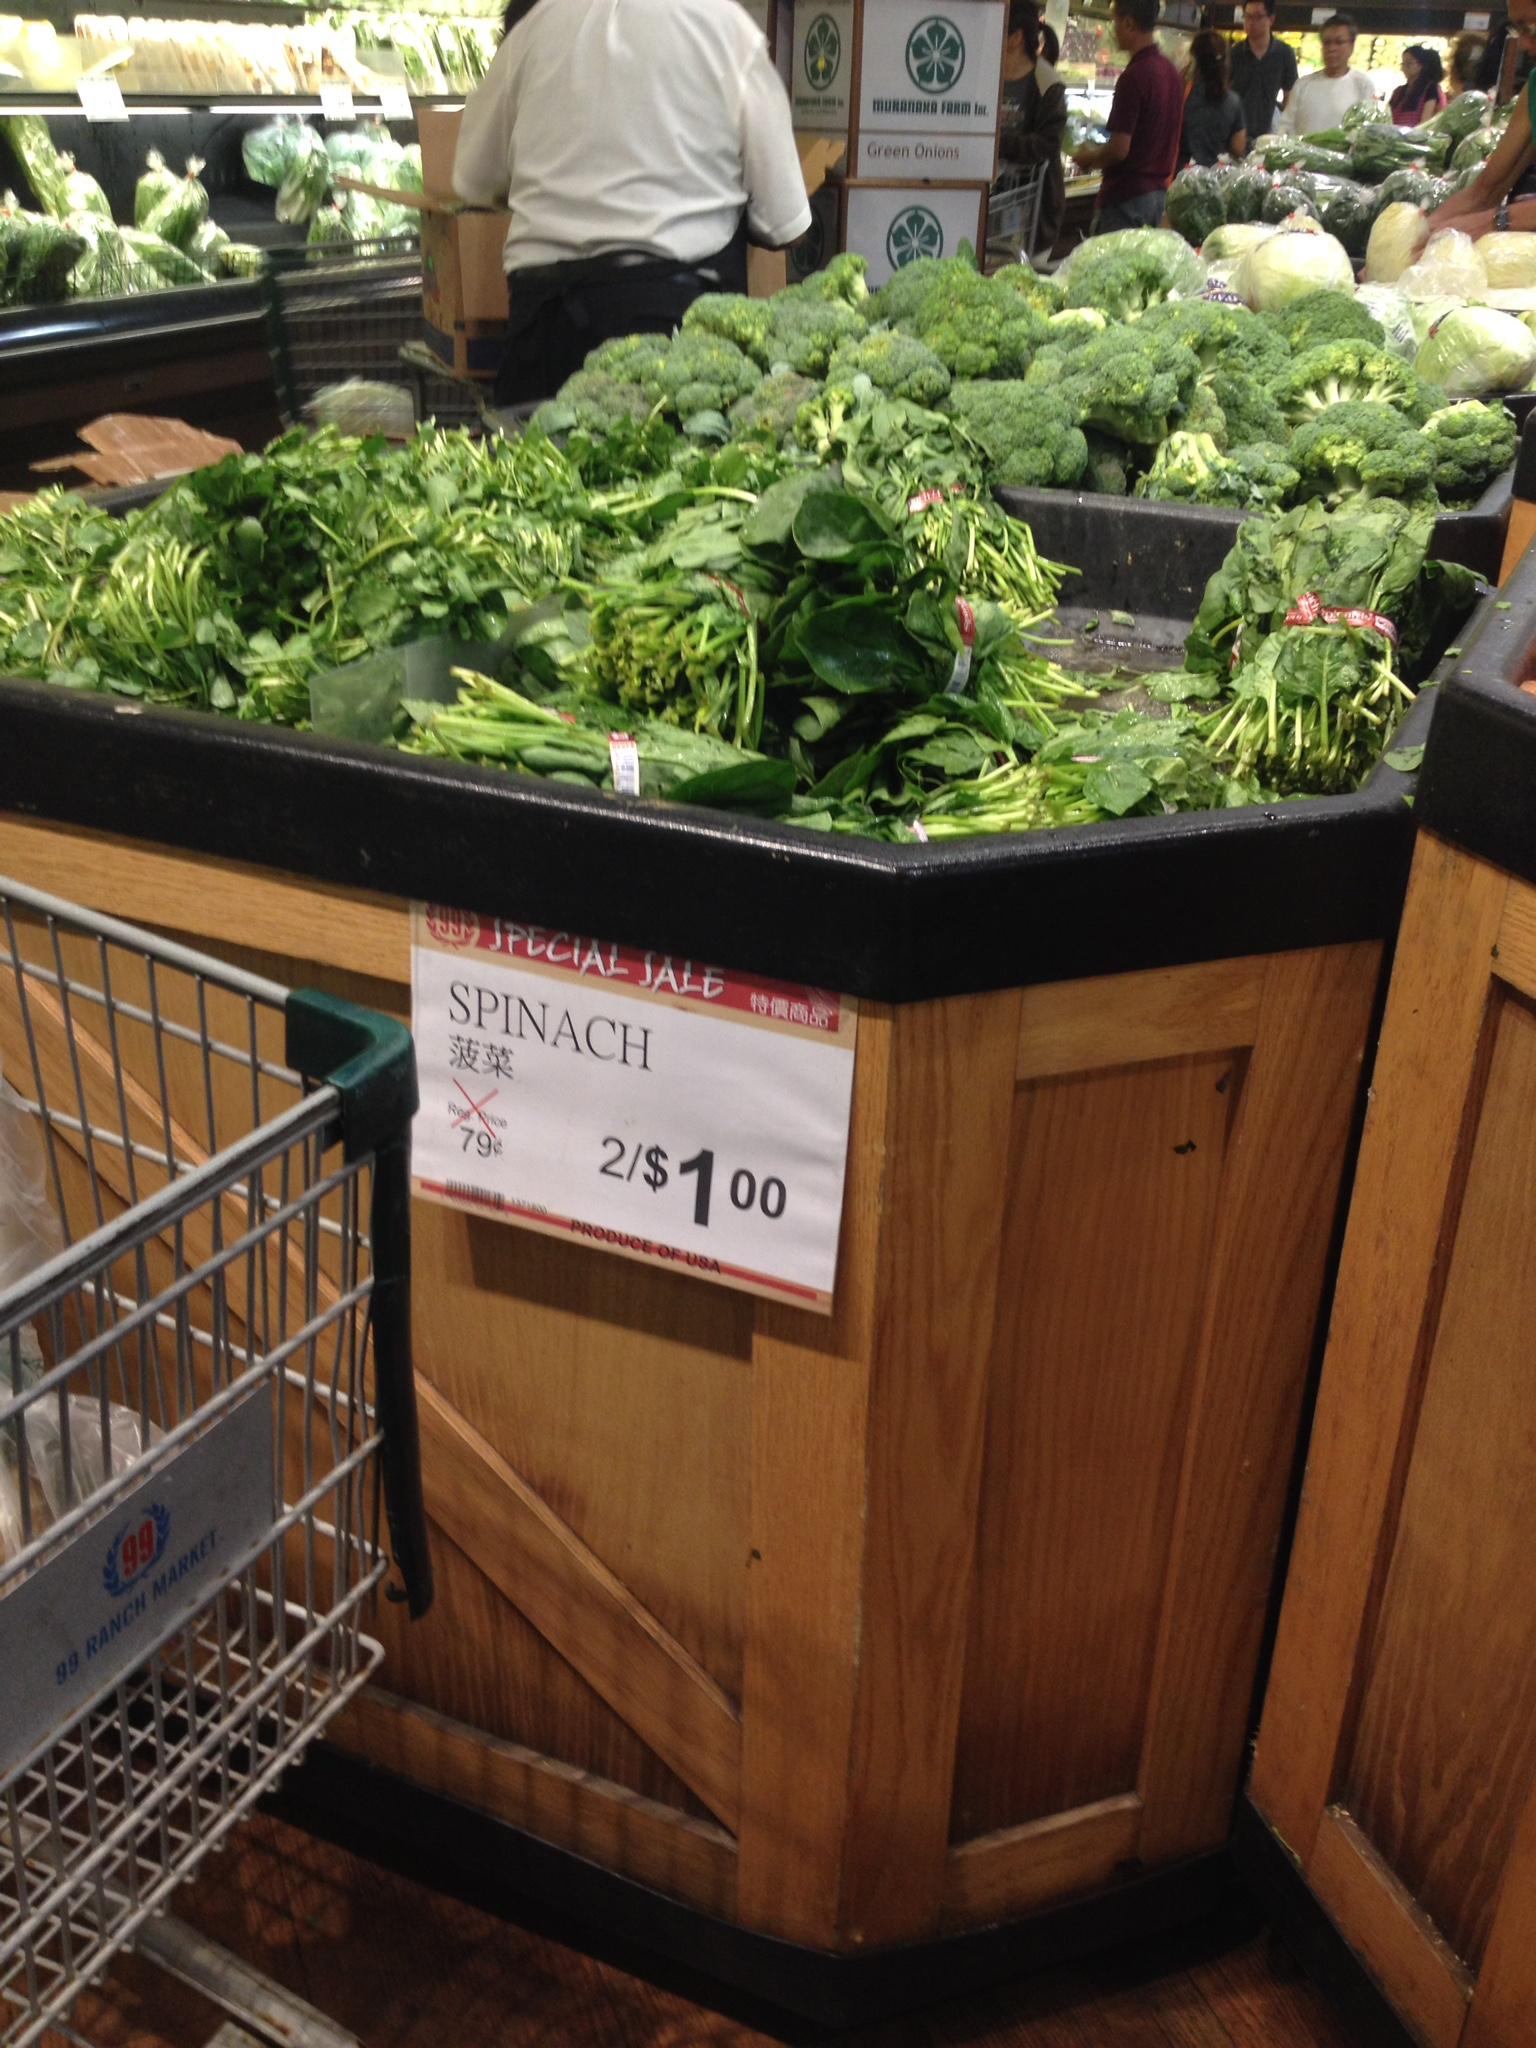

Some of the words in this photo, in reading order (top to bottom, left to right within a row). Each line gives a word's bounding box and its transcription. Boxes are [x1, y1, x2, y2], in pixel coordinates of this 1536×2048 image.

[941, 101, 971, 116] FARM
[867, 141, 910, 158] Green
[914, 143, 960, 160] Onions
[488, 918, 630, 976] SPECIAL
[638, 952, 725, 1000] SALE
[449, 980, 653, 1071] SPINACH
[449, 1033, 514, 1080] 菠菜
[570, 1219, 653, 1256] PRODUCE
[658, 1243, 681, 1261] OF
[686, 1251, 721, 1274] USA
[122, 1520, 154, 1577] 99
[55, 1652, 79, 1685] 99
[86, 1593, 146, 1659] RANCH
[152, 1530, 217, 1599] MARKET
